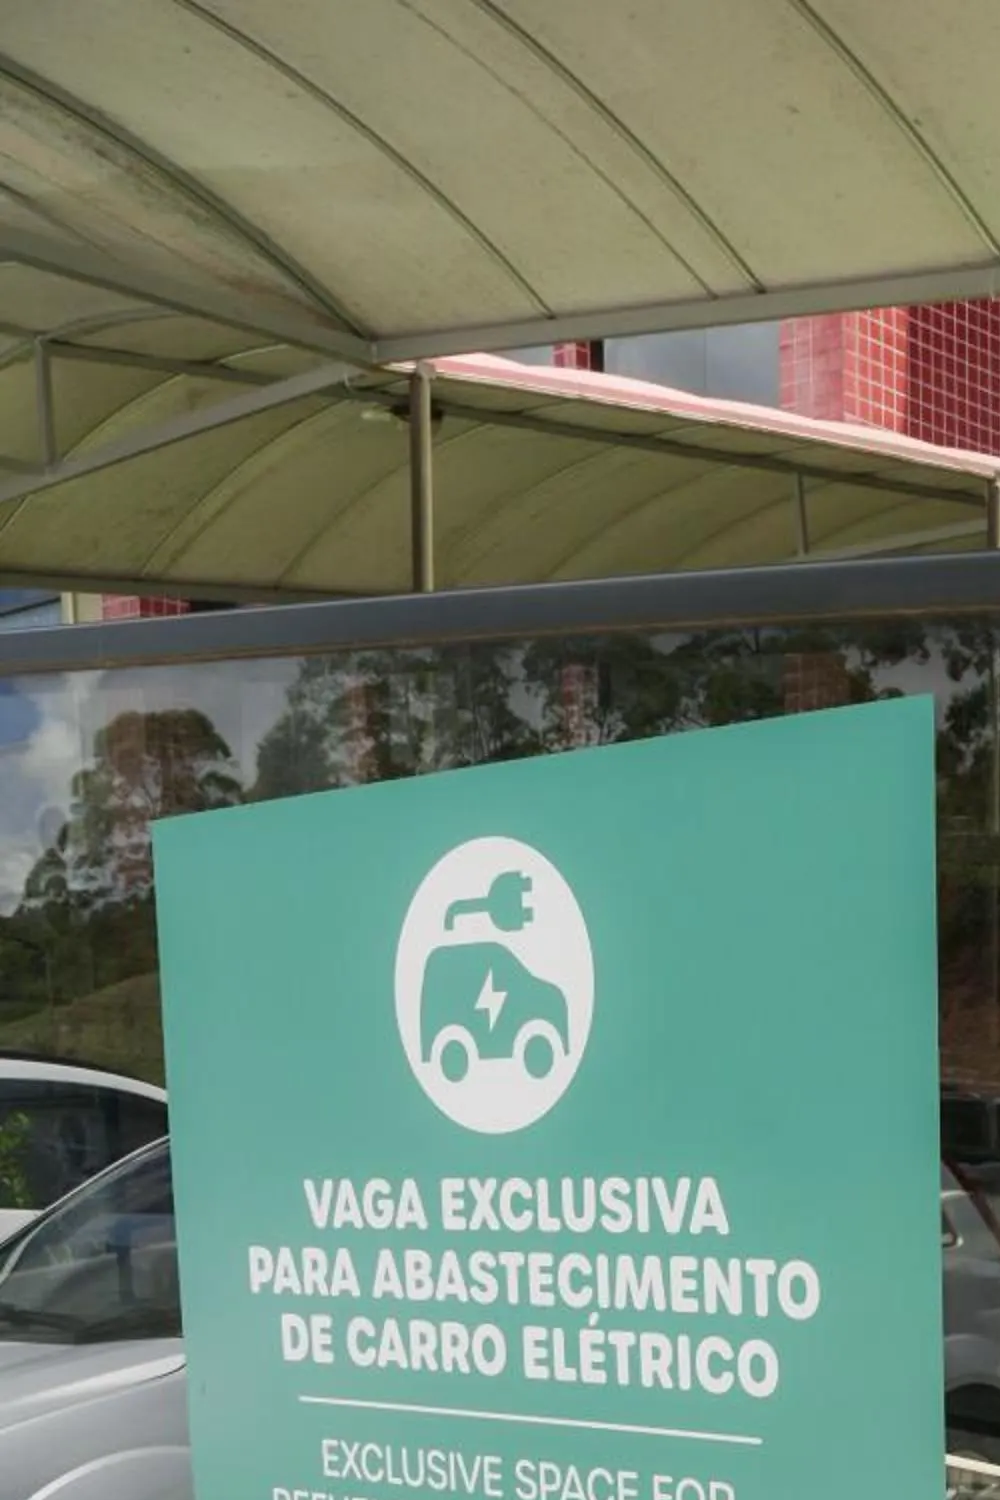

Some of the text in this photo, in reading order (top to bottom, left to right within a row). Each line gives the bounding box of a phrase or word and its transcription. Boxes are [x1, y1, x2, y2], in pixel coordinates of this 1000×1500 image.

[304, 1176, 730, 1236] VAGA EXCLUSIVA
[248, 1245, 821, 1321] PARA ABASTECIMENTO
[281, 1312, 780, 1398] DE CARRO ELÉTRICO
[321, 1438, 504, 1498] EXCLUSIVE
